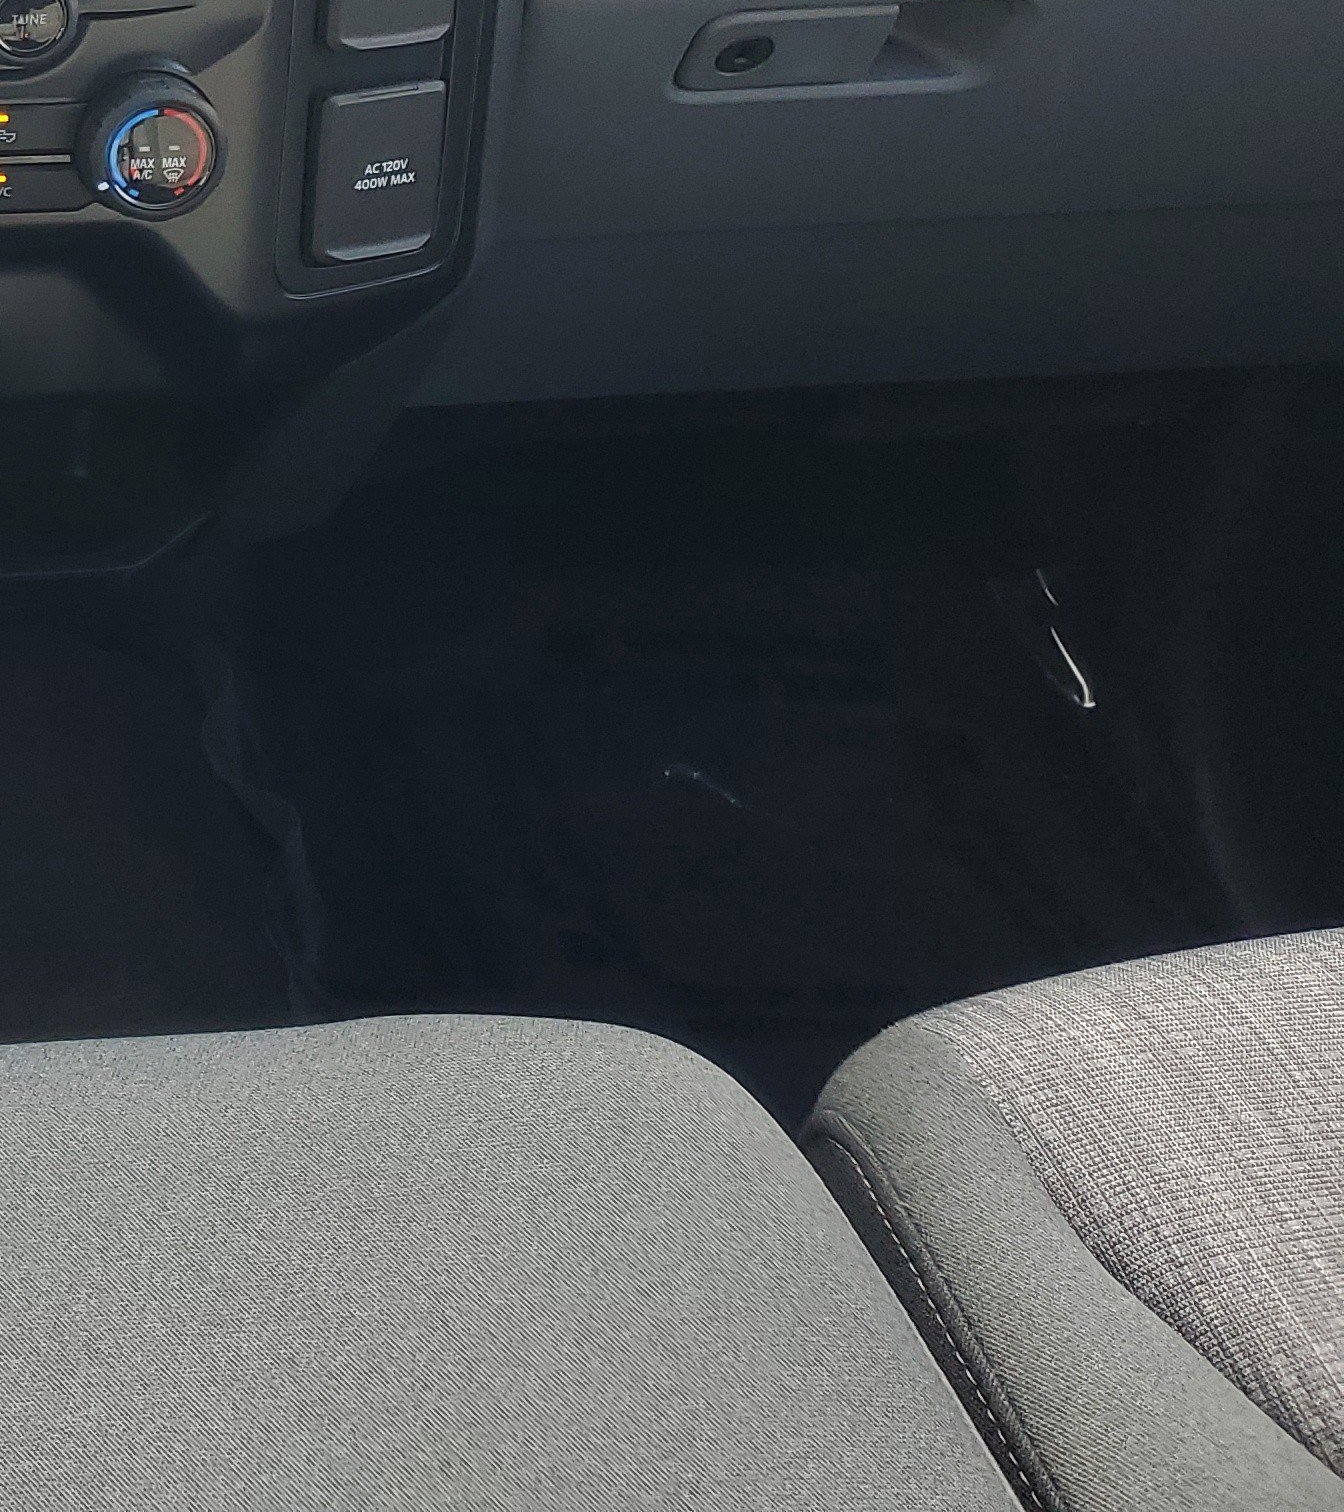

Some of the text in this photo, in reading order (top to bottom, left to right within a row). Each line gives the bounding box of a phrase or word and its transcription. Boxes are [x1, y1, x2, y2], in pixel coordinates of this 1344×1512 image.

[12, 13, 47, 25] TUNE
[130, 158, 155, 169] MAX
[162, 157, 187, 168] MAX
[365, 158, 409, 175] AC 120V
[133, 169, 153, 180] A/C
[354, 171, 415, 191] 400W MAX
